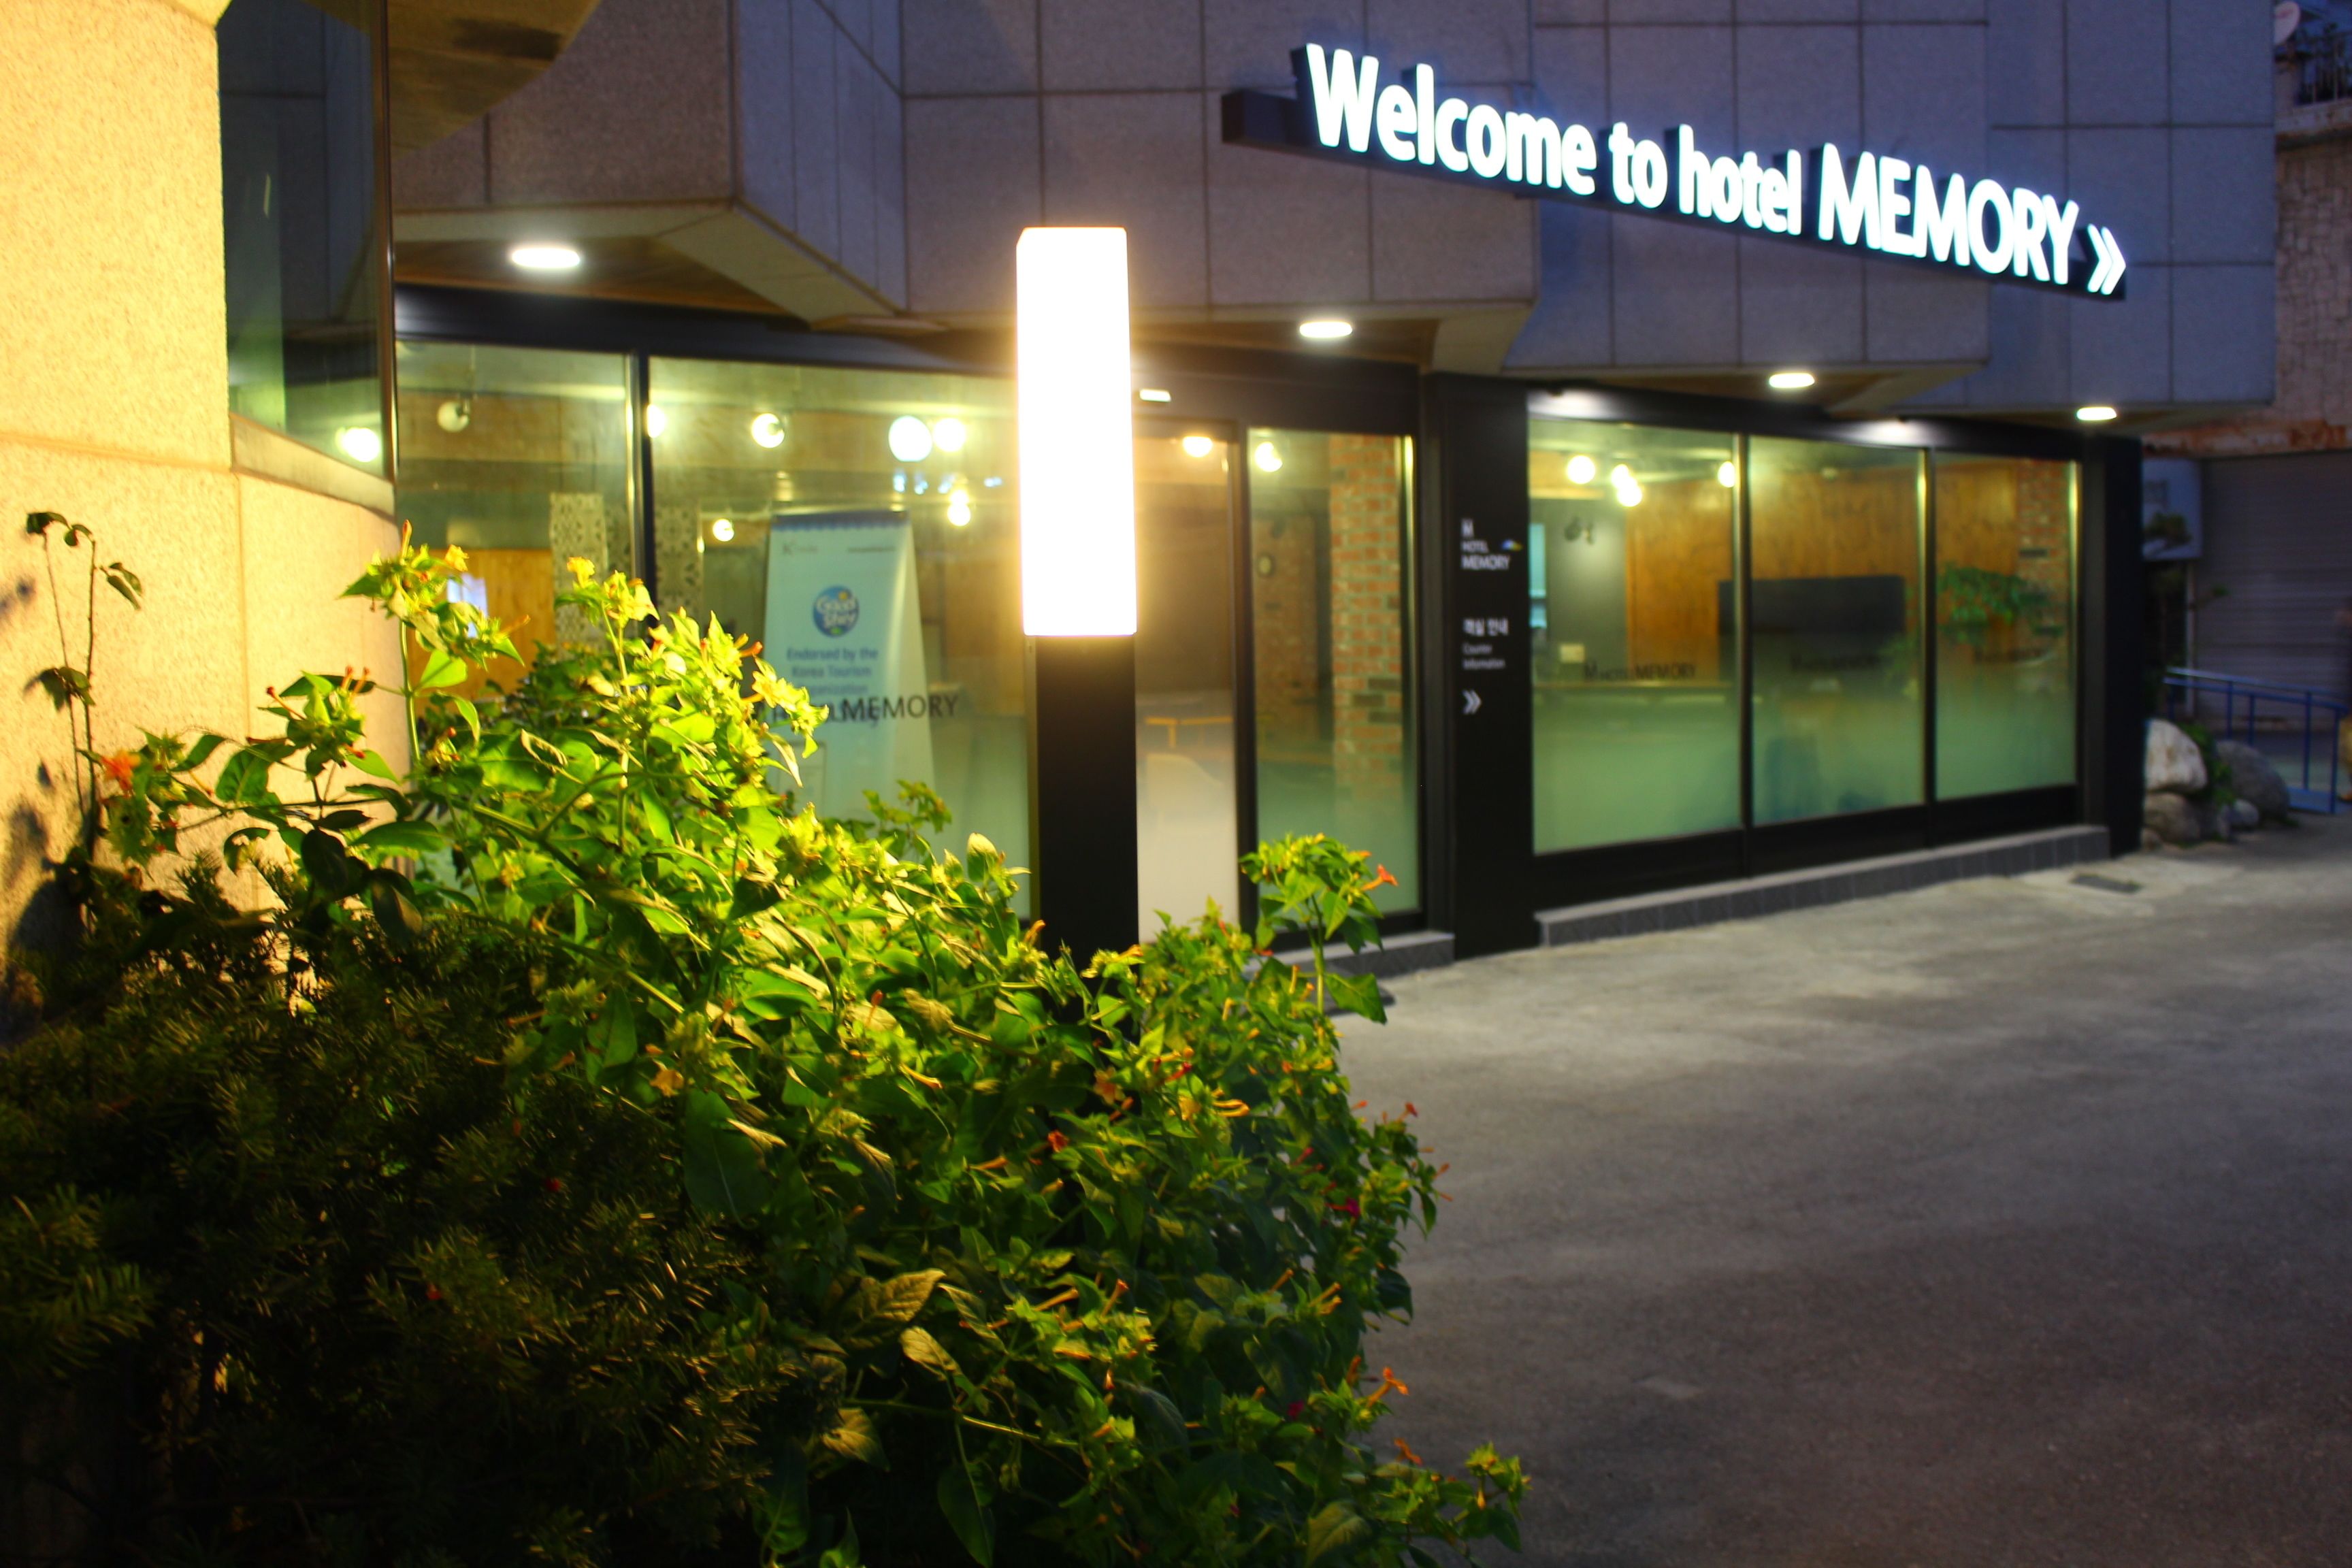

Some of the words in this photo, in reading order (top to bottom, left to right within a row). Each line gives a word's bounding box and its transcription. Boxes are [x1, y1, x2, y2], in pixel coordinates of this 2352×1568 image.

[1305, 43, 1597, 196] Welcome
[1608, 121, 1669, 209] to
[1678, 124, 1802, 235] hotel
[1818, 142, 2080, 285] MEMORY
[1461, 555, 1510, 570] MEMORY
[841, 694, 960, 722] MEMORY
